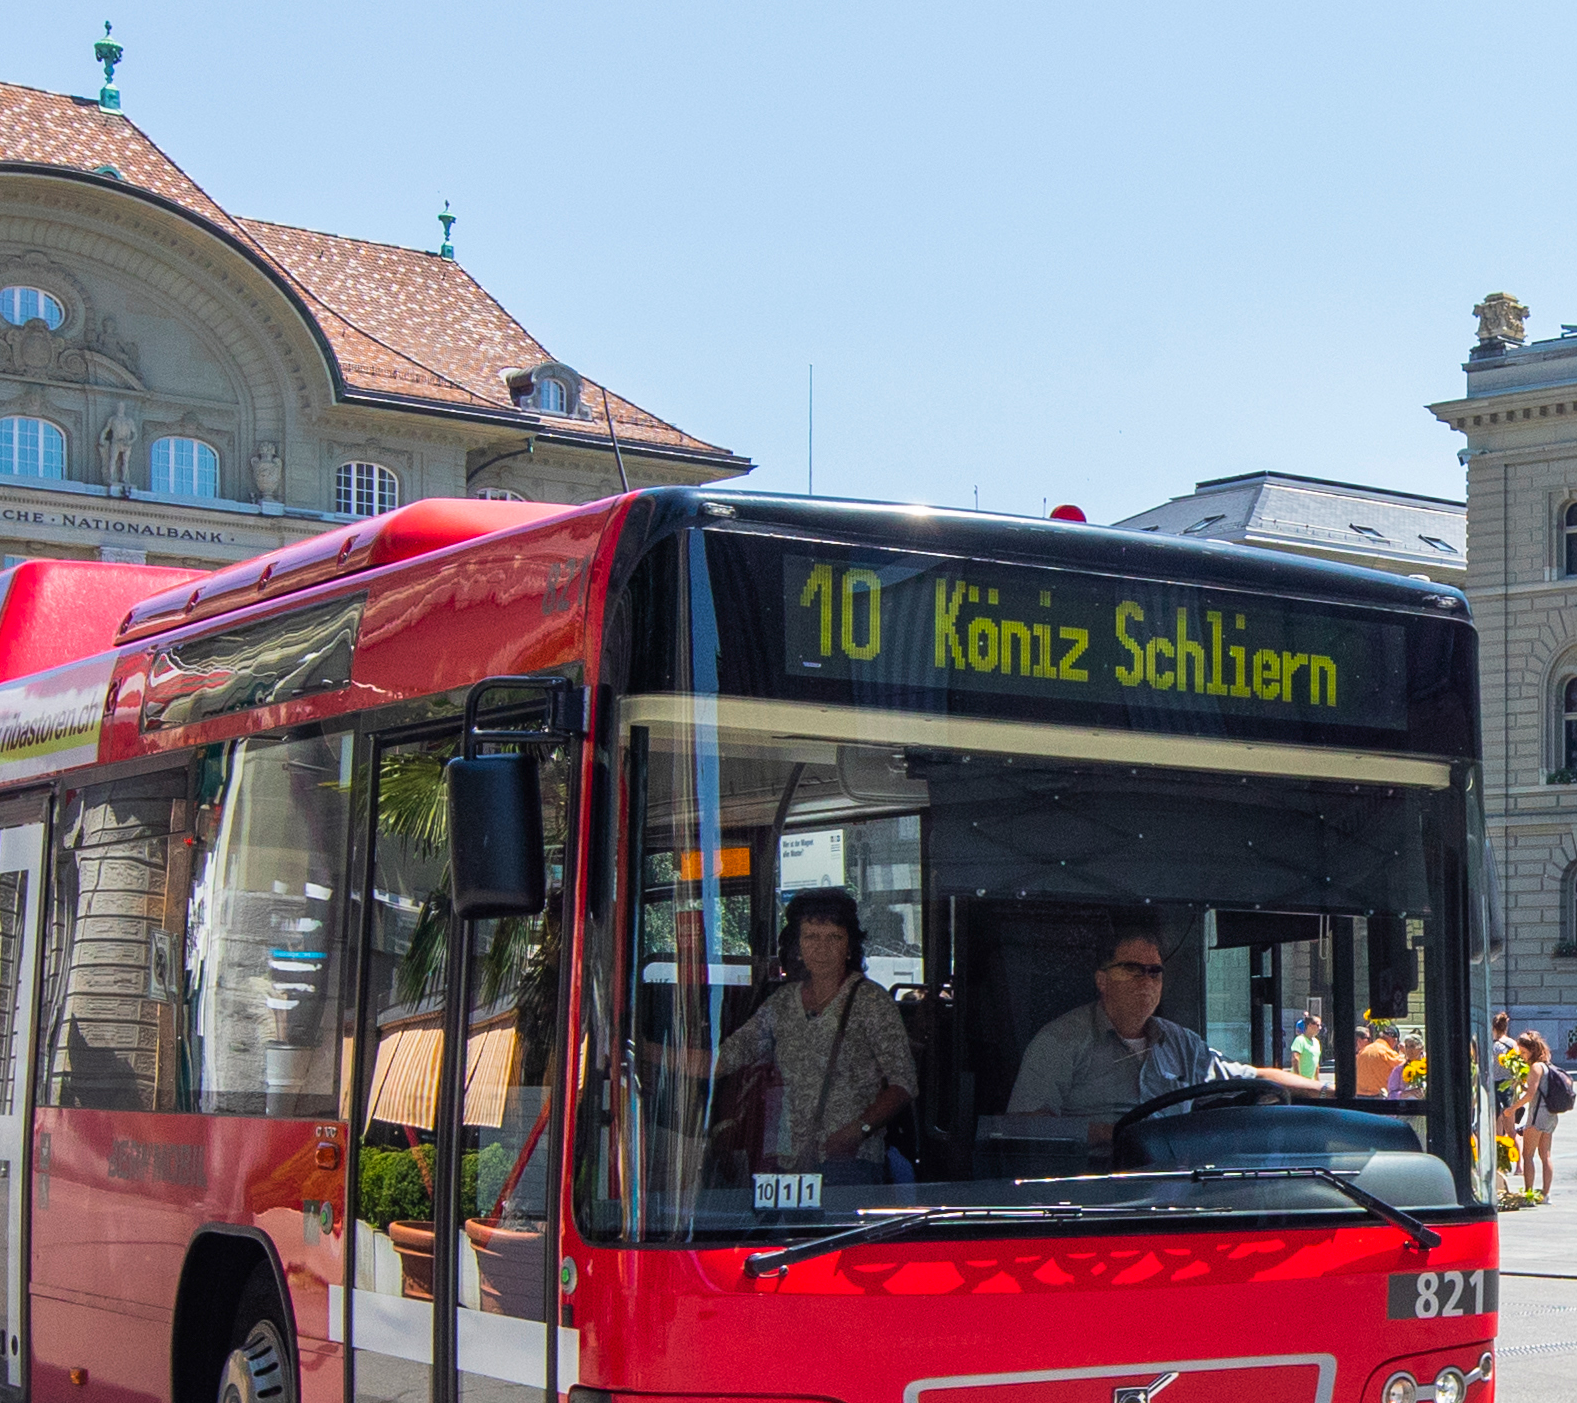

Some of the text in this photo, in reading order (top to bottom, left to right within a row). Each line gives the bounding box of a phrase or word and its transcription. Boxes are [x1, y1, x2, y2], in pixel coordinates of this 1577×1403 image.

[62, 514, 223, 543] NATIONALBANK
[542, 553, 591, 615] 821
[800, 564, 1337, 707] 10 Köniz Schliern
[757, 1183, 774, 1201] 10
[783, 1183, 791, 1200] 1
[806, 1183, 814, 1200] 1
[1415, 1269, 1485, 1319] 821
